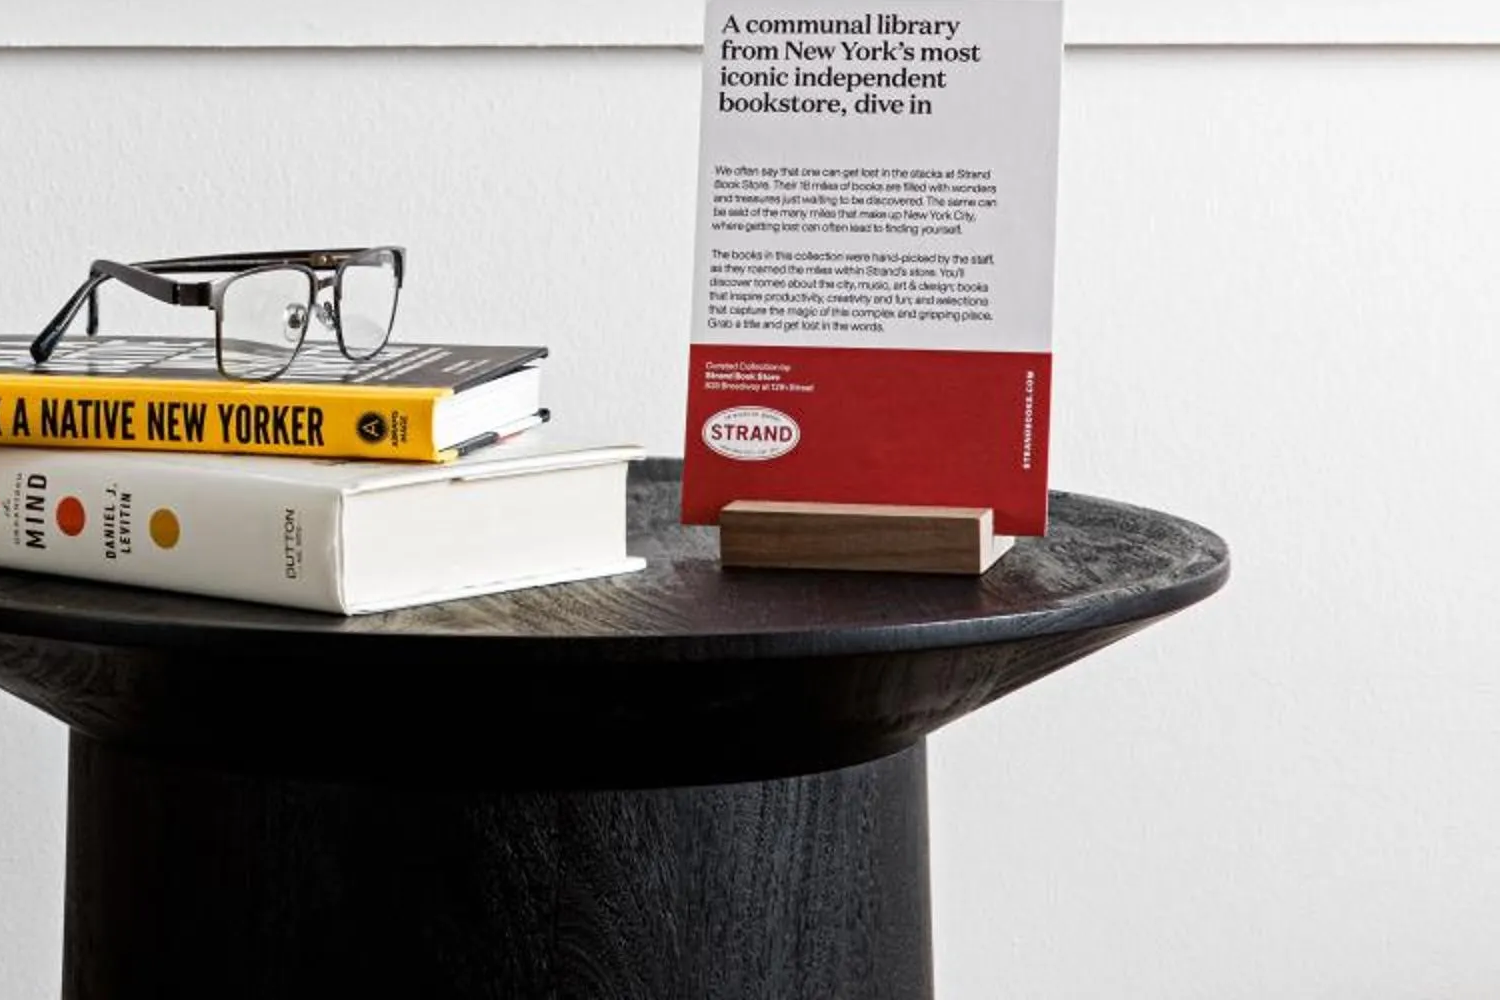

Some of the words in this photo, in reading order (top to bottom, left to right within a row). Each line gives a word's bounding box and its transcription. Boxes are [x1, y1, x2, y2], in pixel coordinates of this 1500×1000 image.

[721, 14, 740, 35] A
[745, 13, 871, 35] communal
[876, 13, 960, 40] library
[721, 39, 779, 60] from
[784, 41, 836, 61] New
[841, 40, 916, 62] York's
[920, 43, 981, 63] most
[720, 66, 789, 87] iconic
[794, 66, 947, 92] independent
[718, 91, 848, 117] bookstore,
[854, 93, 904, 115] dive
[909, 93, 933, 115] in
[957, 168, 992, 180] Strand
[11, 396, 32, 438] A
[40, 396, 137, 441] NATIVE
[146, 401, 208, 443] NEW
[216, 403, 326, 447] YORKER
[710, 423, 793, 443] STRAND
[108, 482, 119, 497] J.
[25, 472, 48, 550] MIND
[118, 492, 133, 554] LEVITIN
[104, 506, 118, 560] DANIEL
[285, 508, 297, 580] DUTTON
